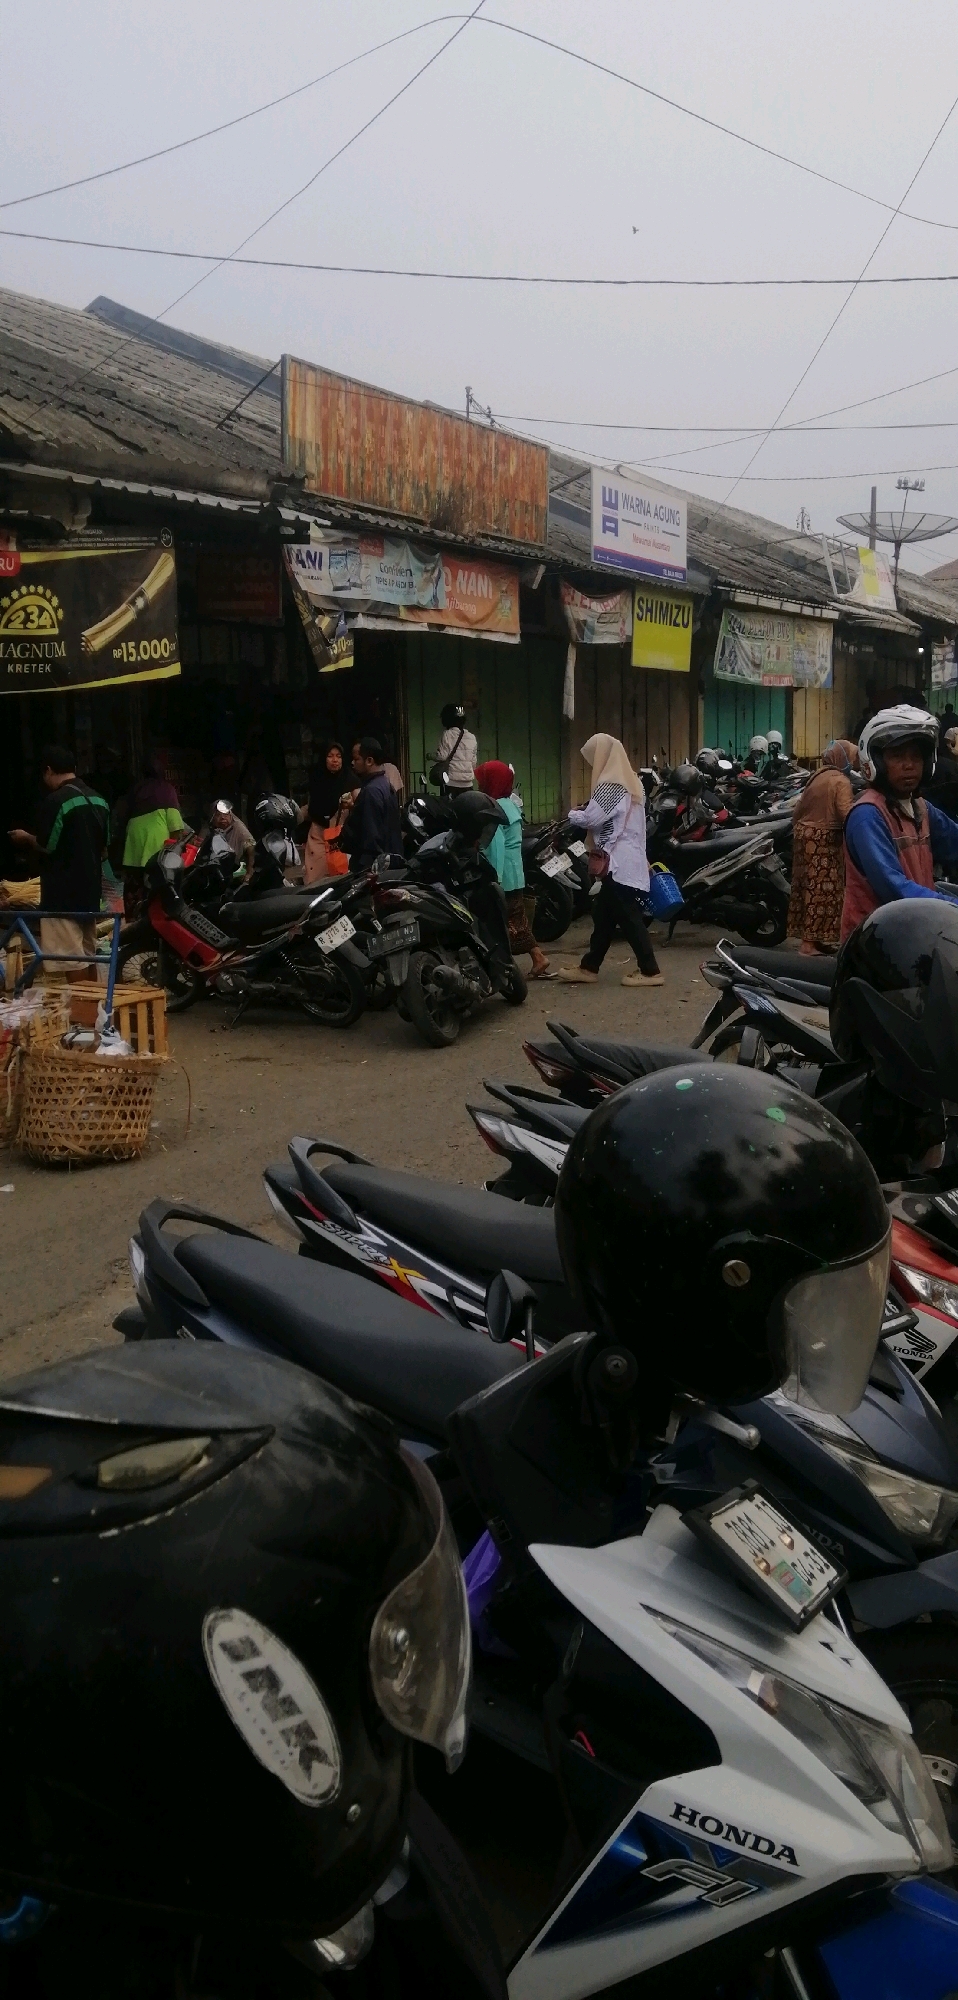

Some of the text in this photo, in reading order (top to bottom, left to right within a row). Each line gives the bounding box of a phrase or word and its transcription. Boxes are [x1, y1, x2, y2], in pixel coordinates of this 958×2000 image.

[621, 492, 681, 527] WARNA AGUNG
[456, 569, 493, 600] NANI
[7, 605, 53, 629] 234
[636, 596, 691, 629] SHIMIZU
[7, 663, 52, 674] KRETEK
[371, 937, 377, 946] R
[893, 1345, 934, 1361] HONDA
[219, 1636, 335, 1783] INK
[669, 1801, 801, 1867] HONDA
